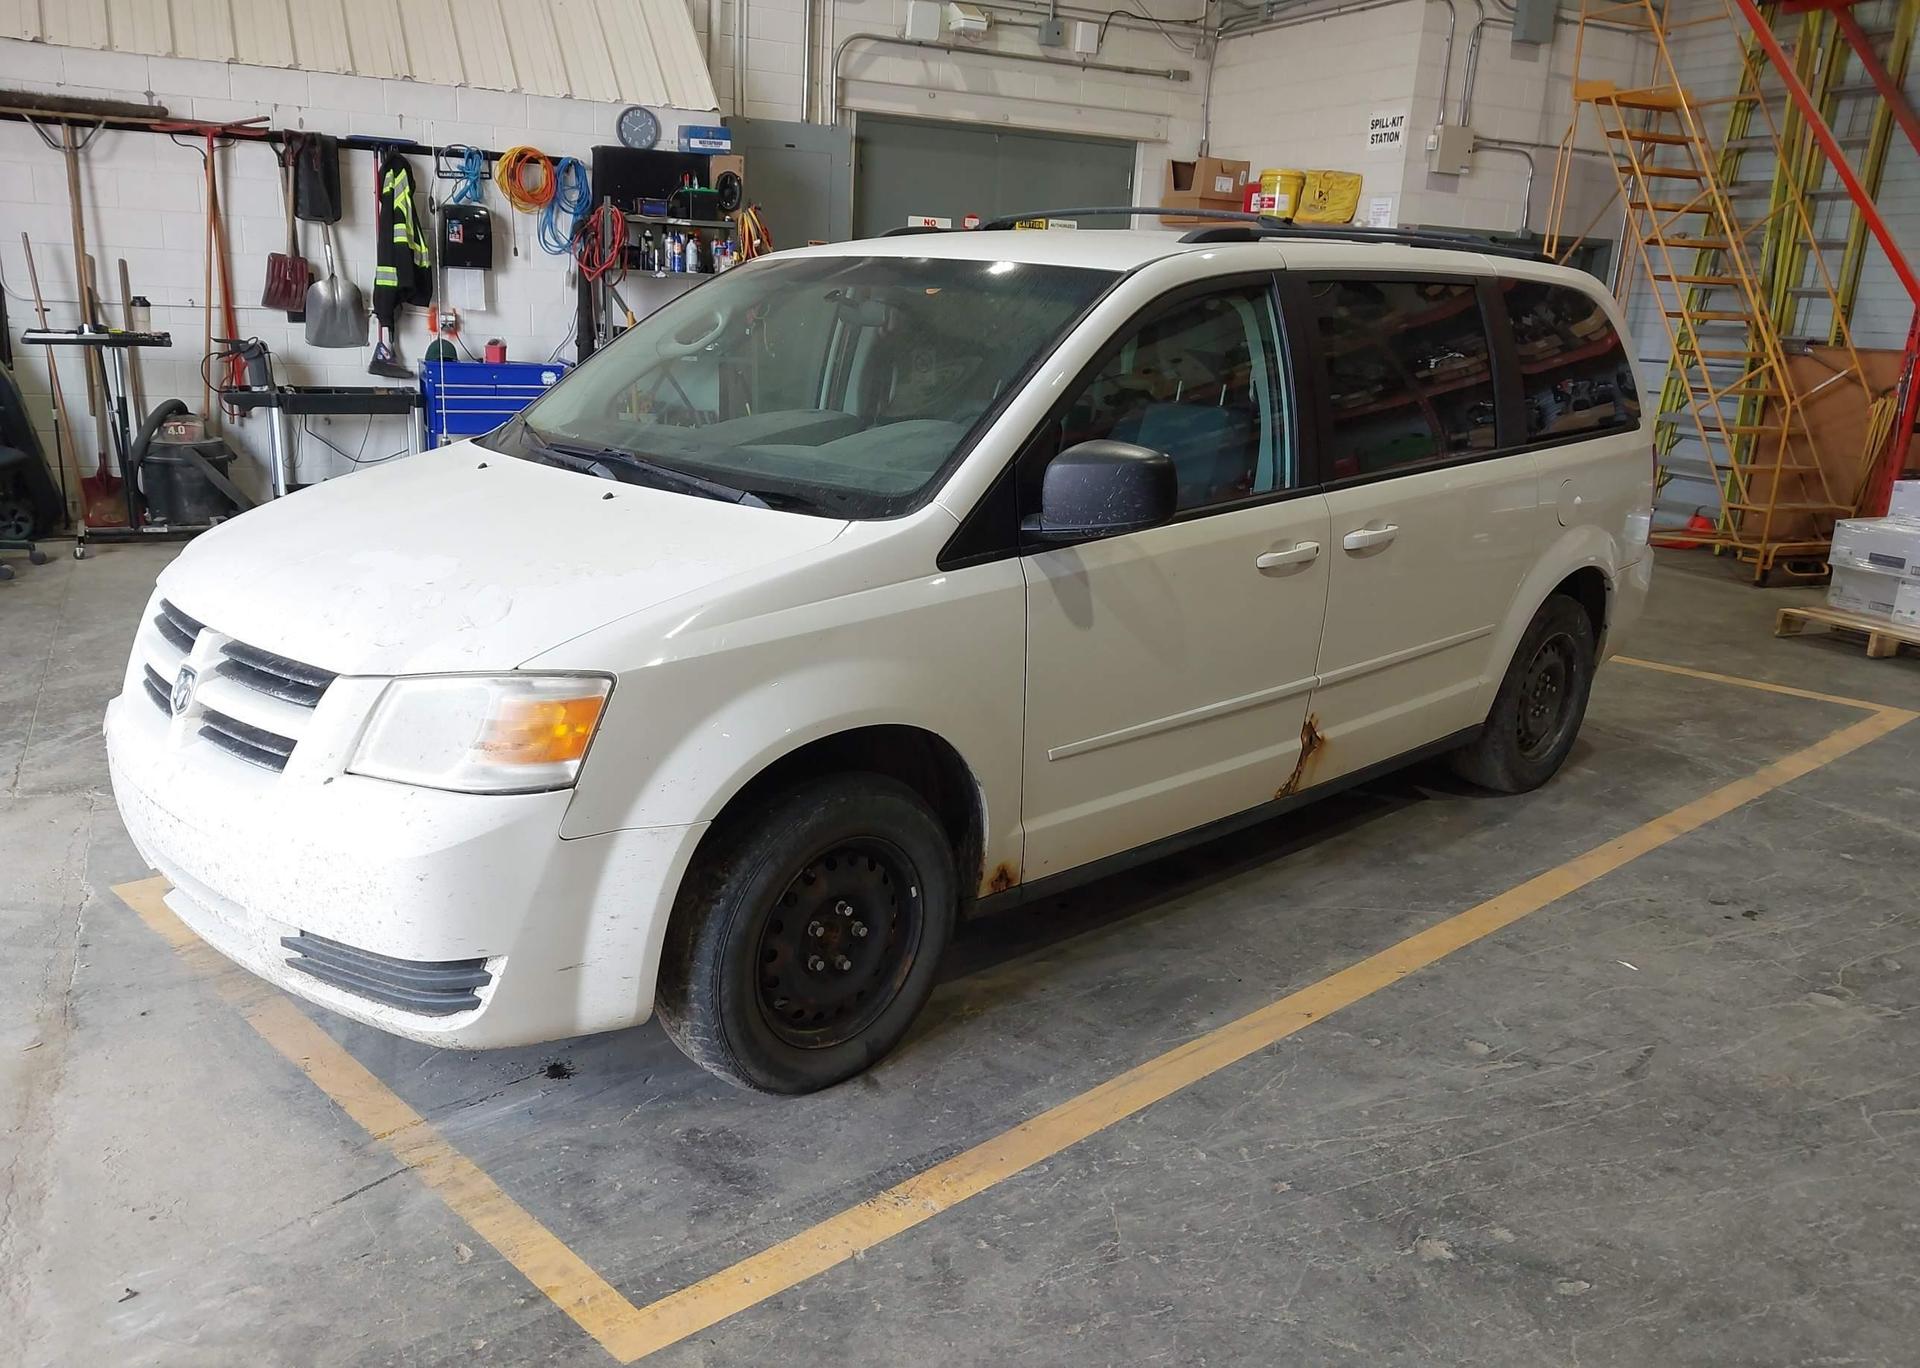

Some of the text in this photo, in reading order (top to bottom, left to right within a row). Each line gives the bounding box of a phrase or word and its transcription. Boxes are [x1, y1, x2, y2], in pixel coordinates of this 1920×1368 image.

[1370, 116, 1404, 130] SPILL-KIT
[1370, 131, 1400, 144] STATION
[923, 218, 937, 227] NO
[1018, 219, 1044, 229] CAUTION
[168, 425, 186, 435] 4.0
